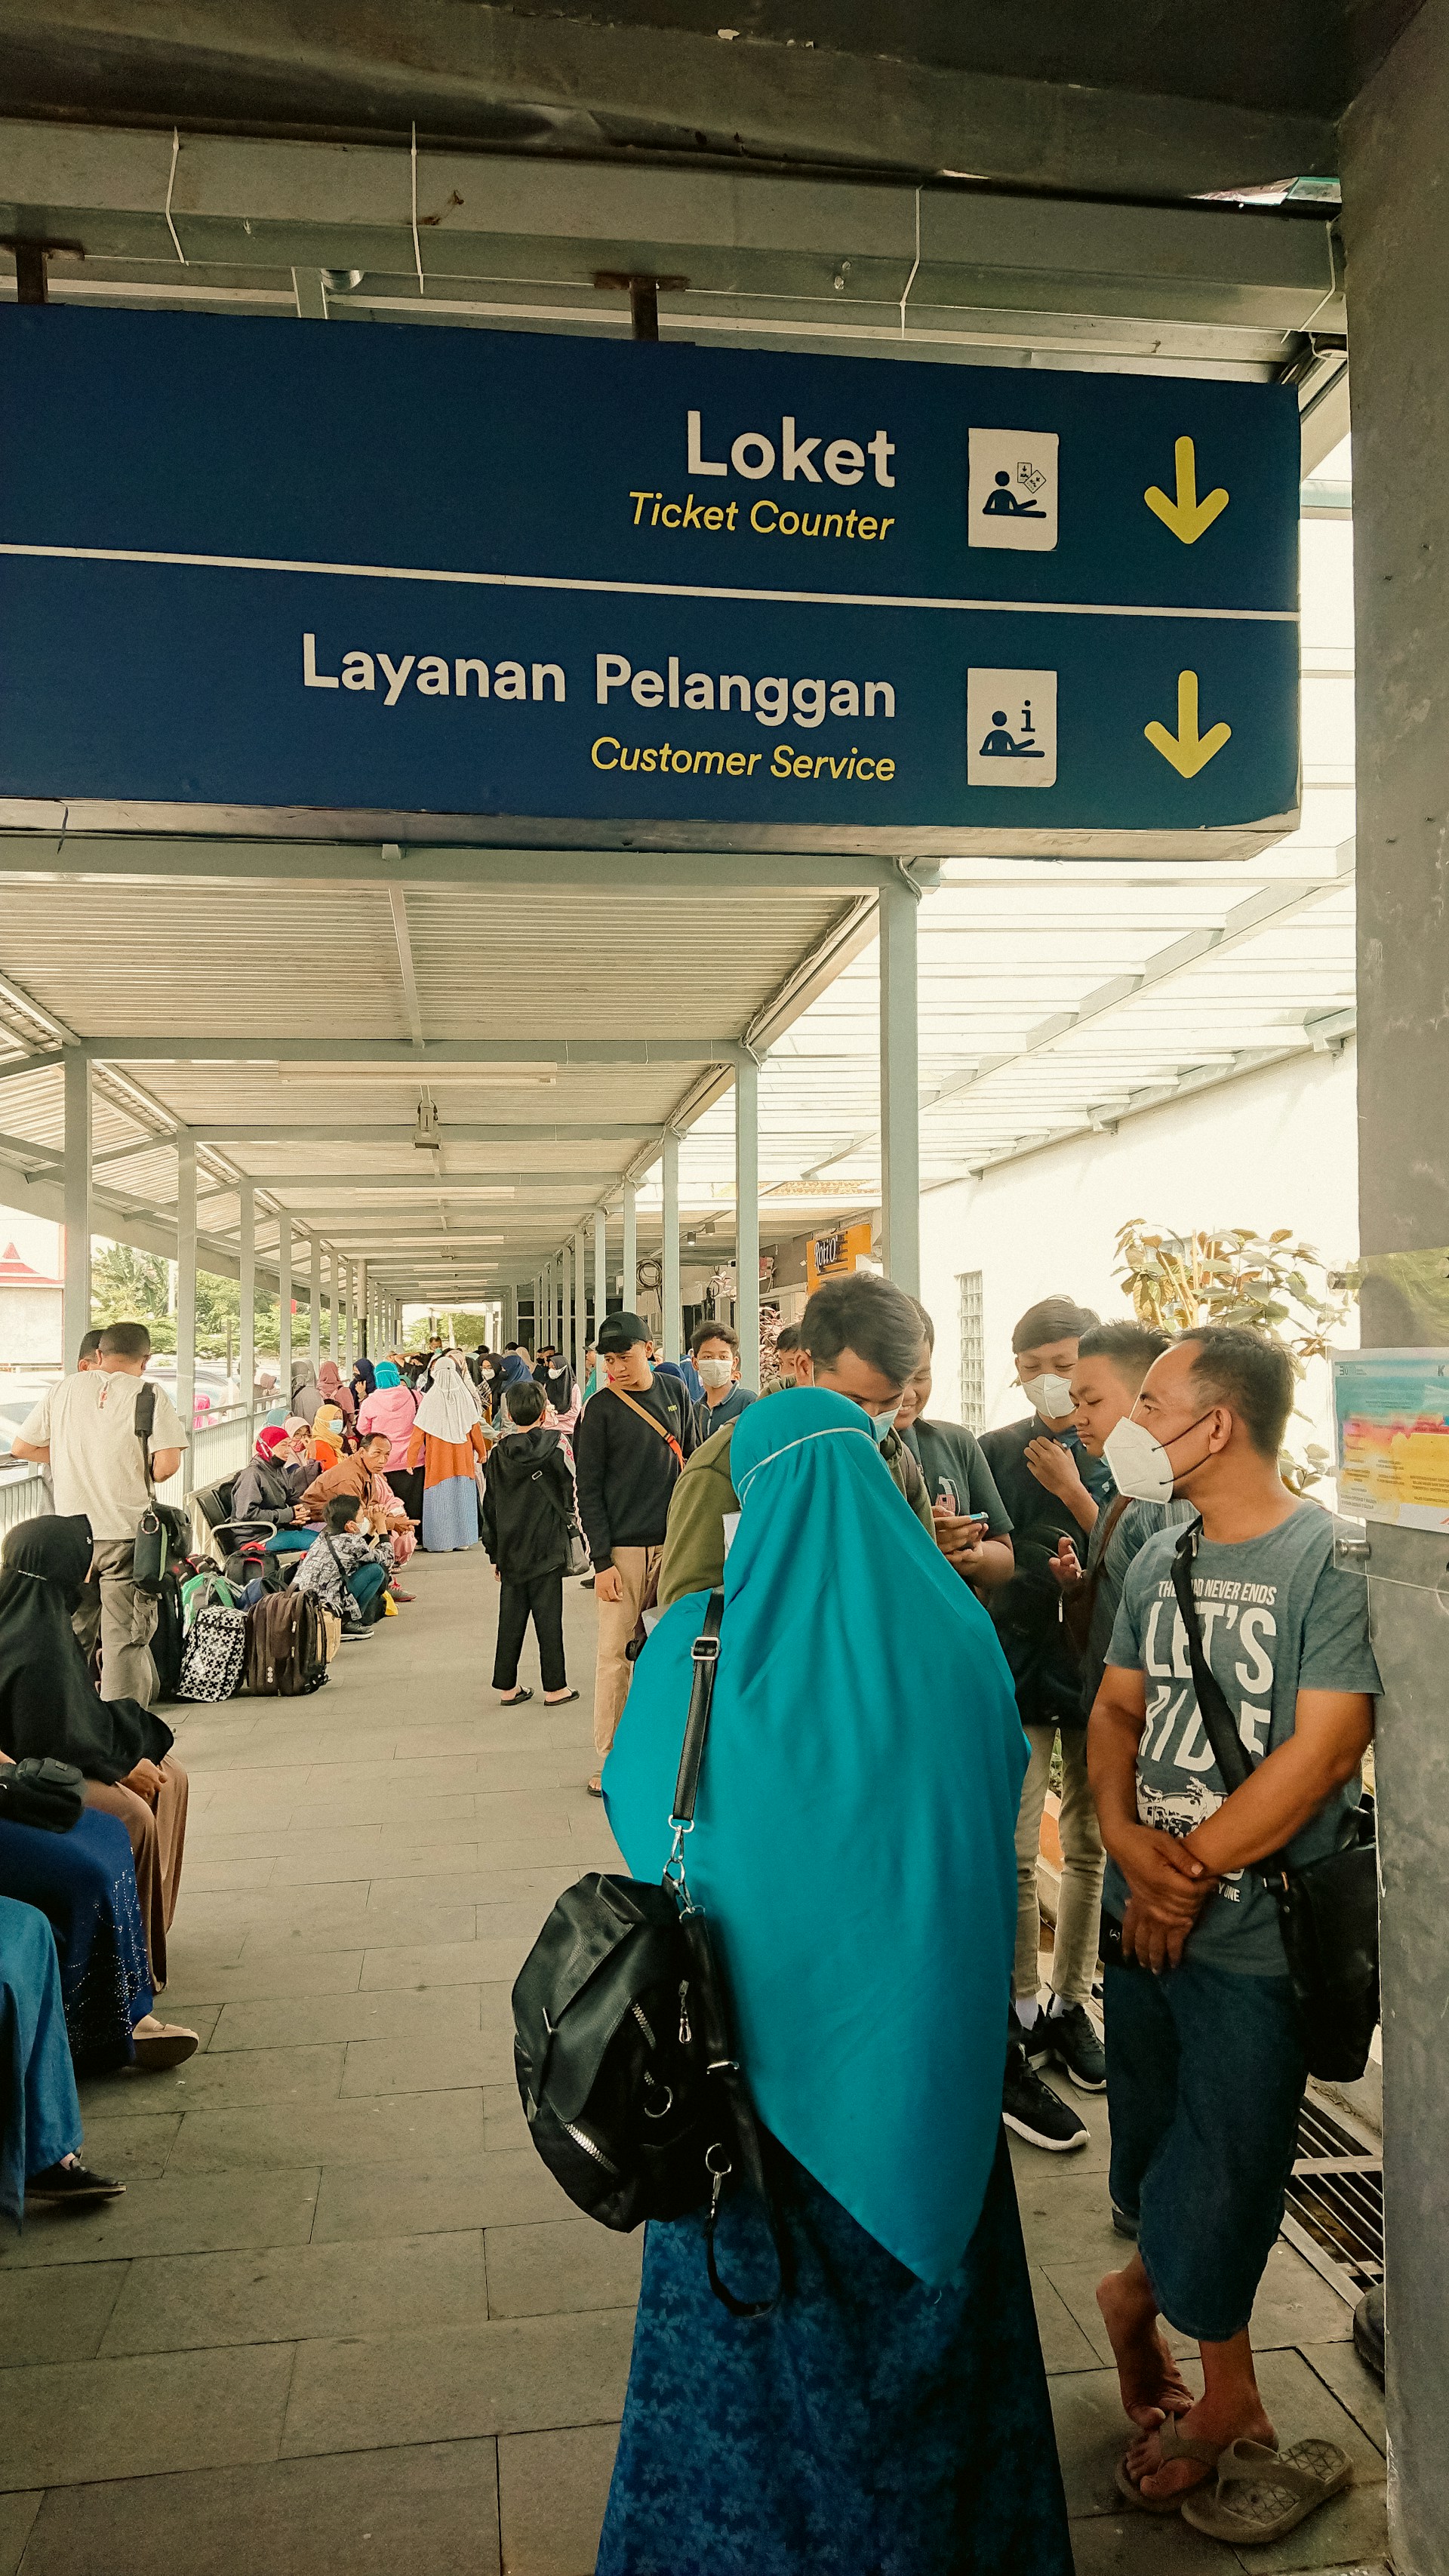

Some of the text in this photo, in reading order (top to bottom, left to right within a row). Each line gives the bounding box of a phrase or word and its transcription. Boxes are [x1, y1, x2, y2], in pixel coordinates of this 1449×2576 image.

[688, 410, 896, 488] Loket
[629, 491, 895, 540] Ticket Counter
[303, 632, 896, 728] Layanan Pelanggan
[591, 736, 896, 781] Customer Service
[1204, 1579, 1241, 1600] NEVER
[1240, 1582, 1277, 1605] ENDS
[1146, 1601, 1277, 1694] LET'S
[1223, 1885, 1241, 1902] ONE
